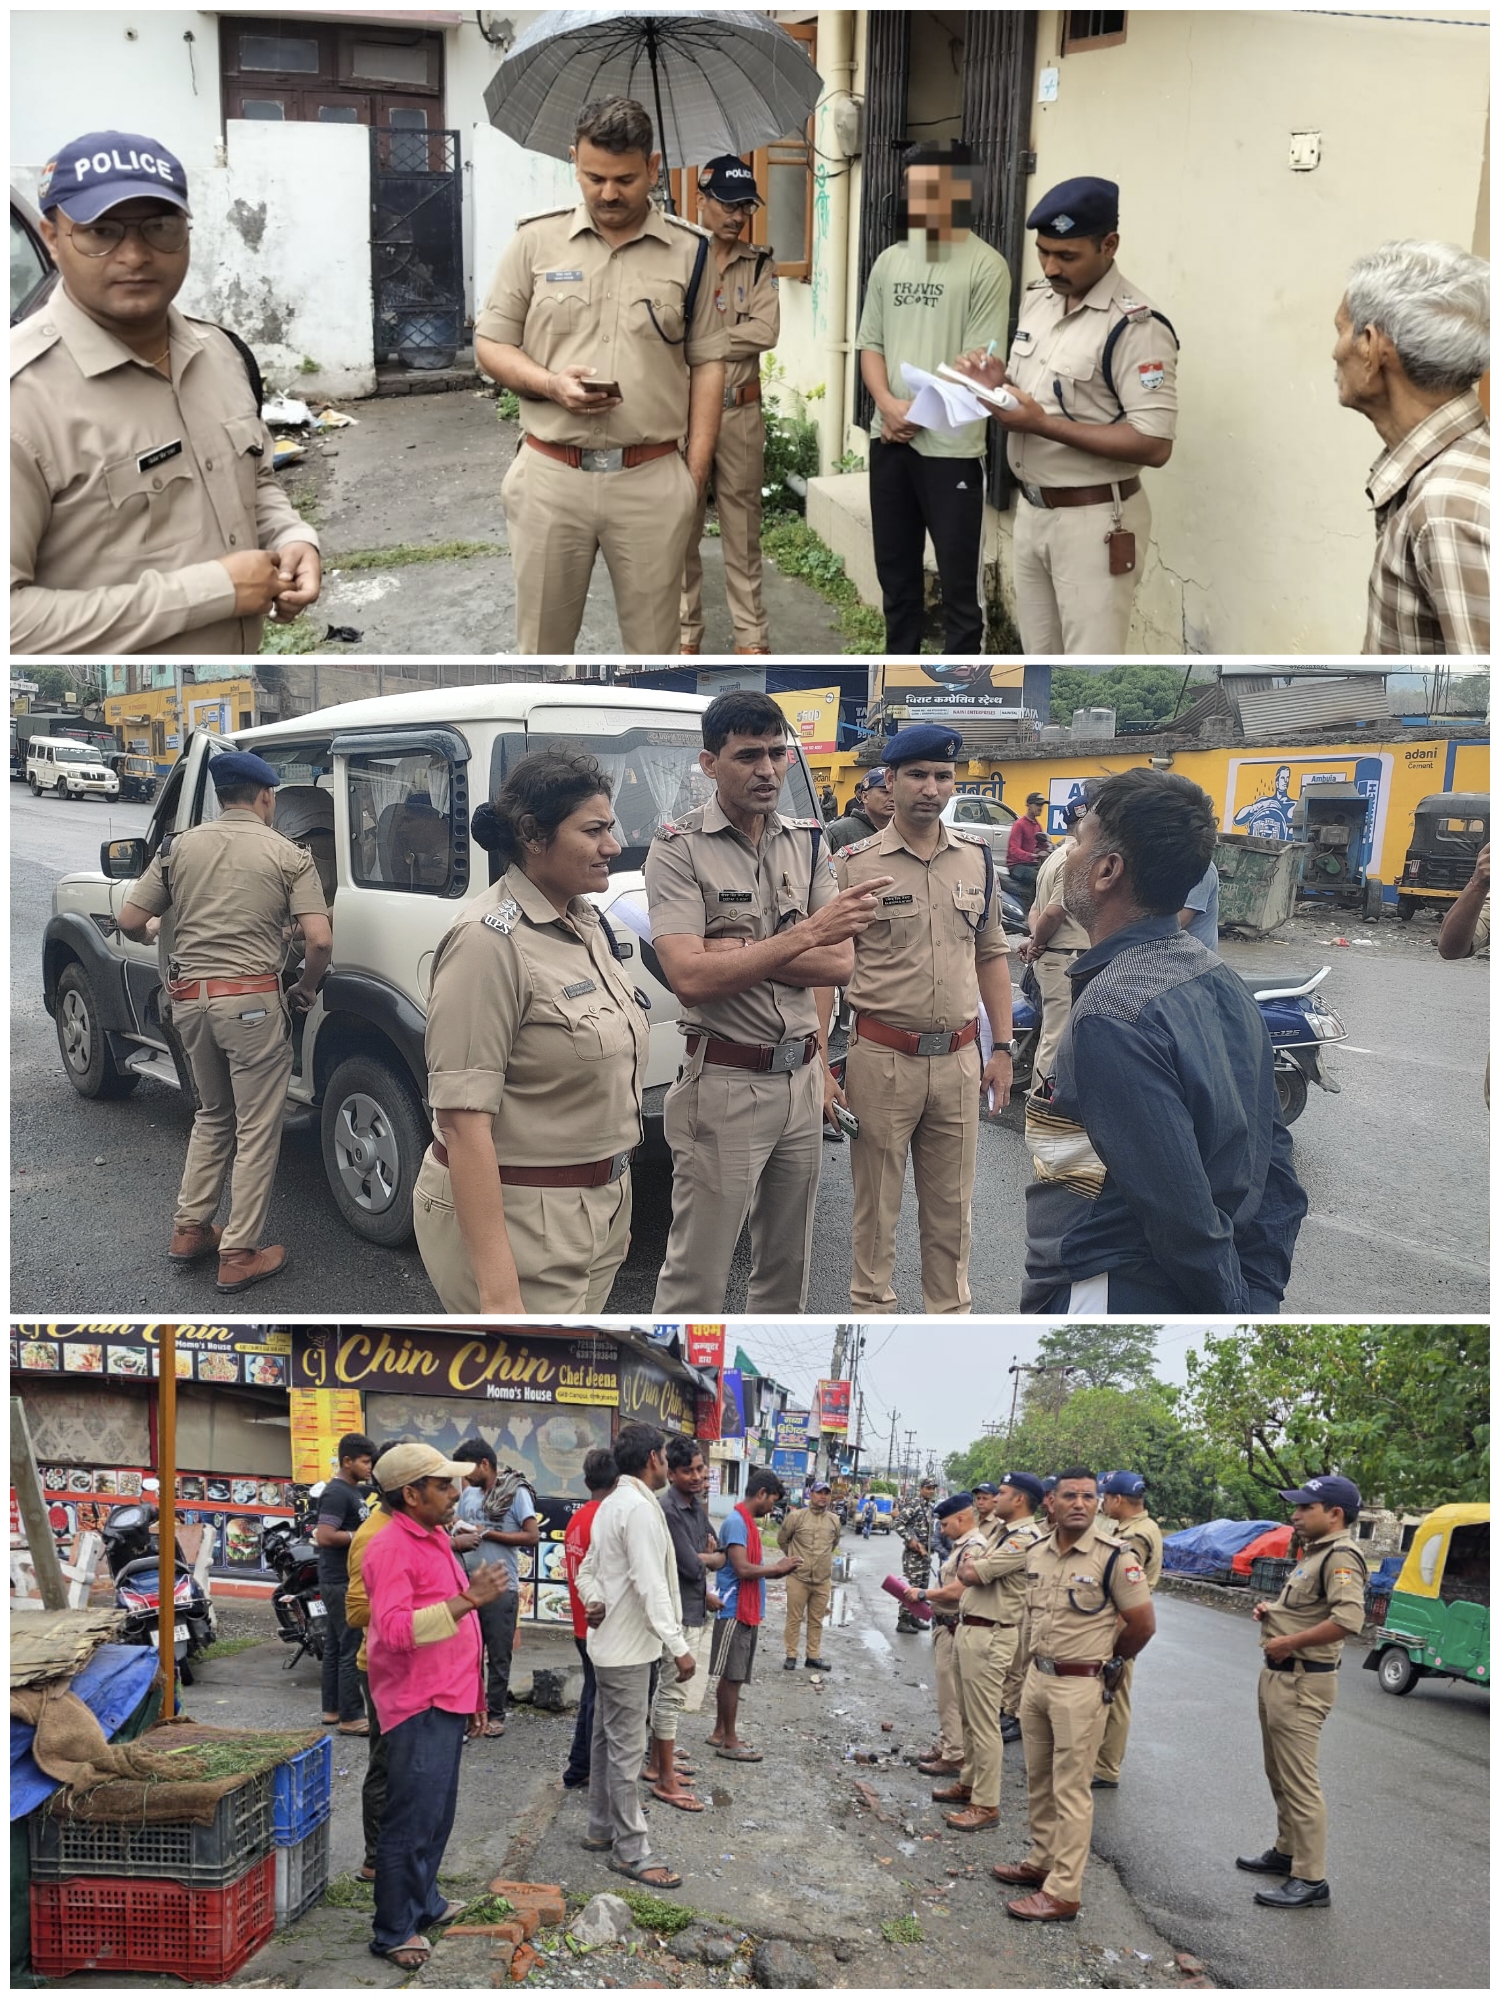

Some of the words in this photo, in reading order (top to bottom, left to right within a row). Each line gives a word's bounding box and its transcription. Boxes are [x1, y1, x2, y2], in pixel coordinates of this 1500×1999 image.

[75, 150, 174, 182] POLICE
[725, 168, 753, 180] POLIC
[893, 281, 945, 296] TRAVIS
[905, 693, 932, 704] विराट
[1404, 747, 1438, 760] adani
[335, 1332, 440, 1383] Chin
[448, 1340, 556, 1391] Chin
[558, 1364, 585, 1386] Chef
[586, 1367, 617, 1388] Jeena
[486, 1384, 522, 1400] Momo's
[524, 1386, 552, 1401] House
